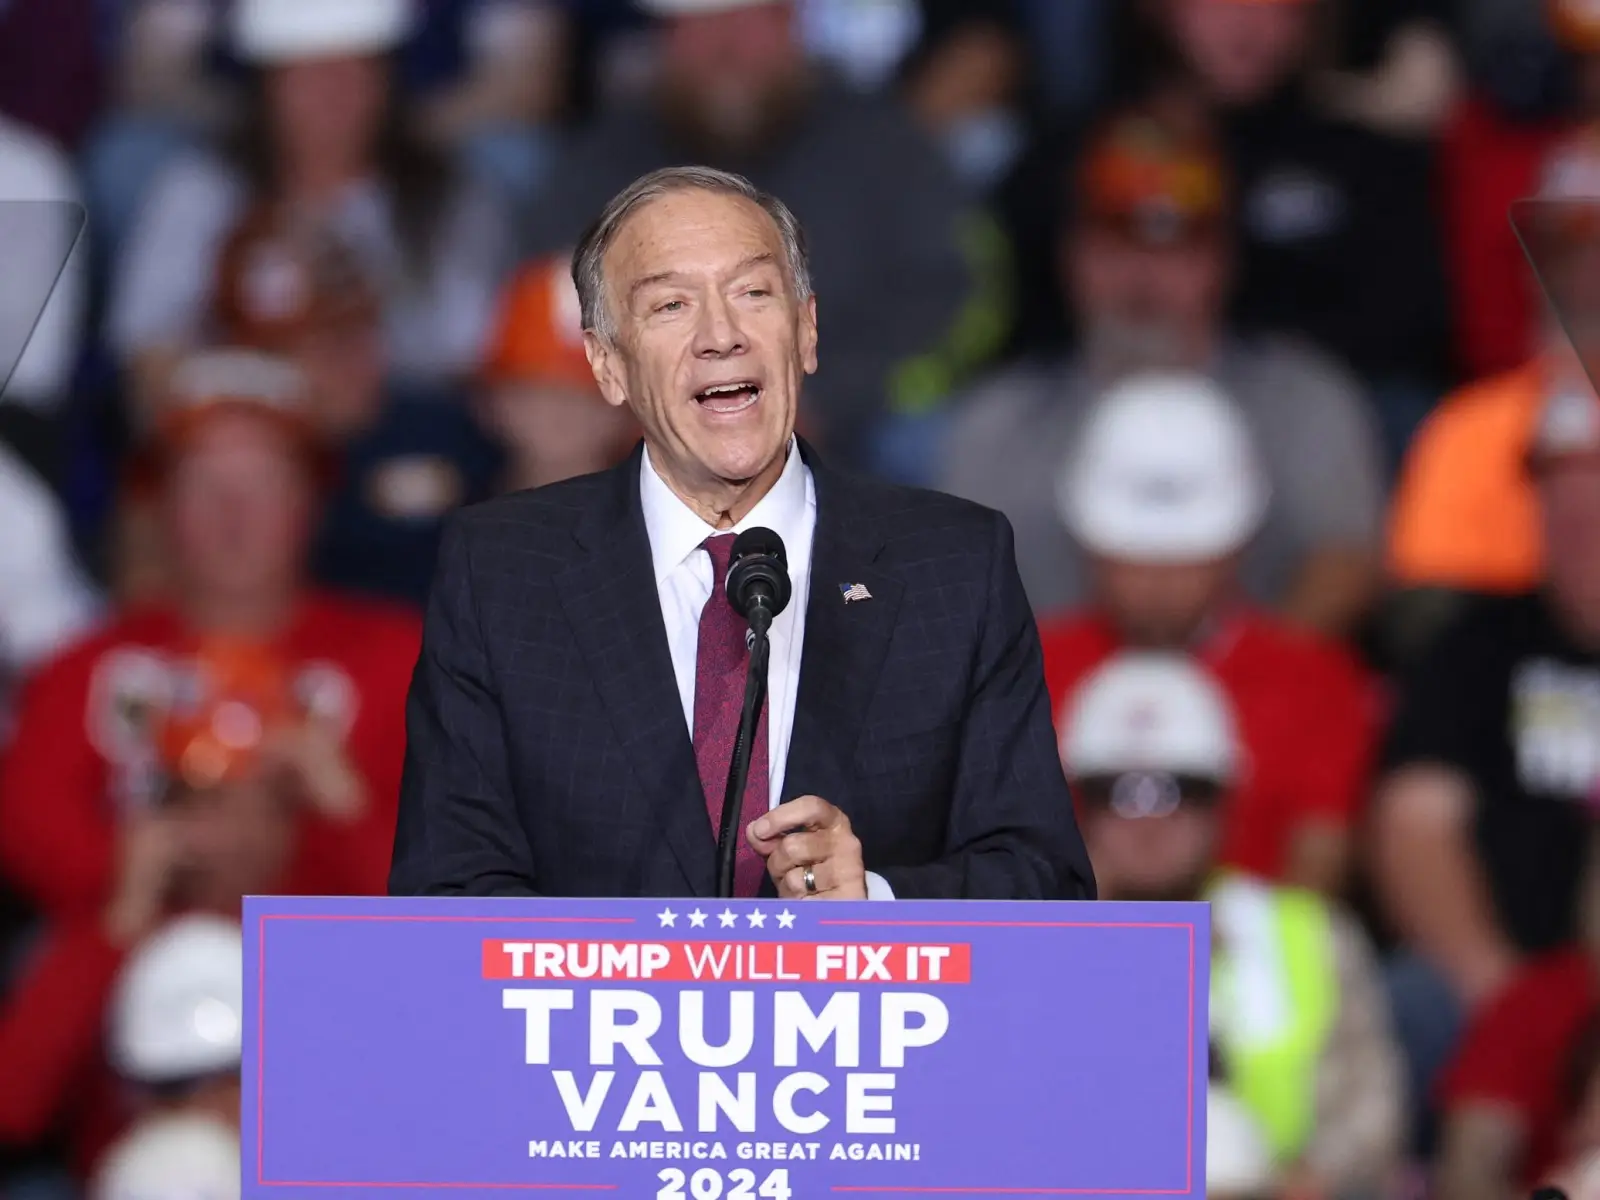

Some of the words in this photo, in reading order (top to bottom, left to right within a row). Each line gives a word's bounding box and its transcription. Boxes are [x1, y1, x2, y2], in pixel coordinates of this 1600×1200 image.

[503, 942, 671, 978] TRUMP
[684, 944, 801, 980] WILL
[816, 945, 892, 981] FIX
[906, 946, 950, 981] IT
[502, 988, 950, 1068] TRUMP
[551, 1070, 896, 1134] VANCE
[528, 1140, 601, 1158] MAKE
[609, 1141, 728, 1160] AMERICA
[736, 1141, 821, 1160] GREAT
[829, 1142, 920, 1161] AGAIN!
[656, 1167, 792, 1200] 2024
